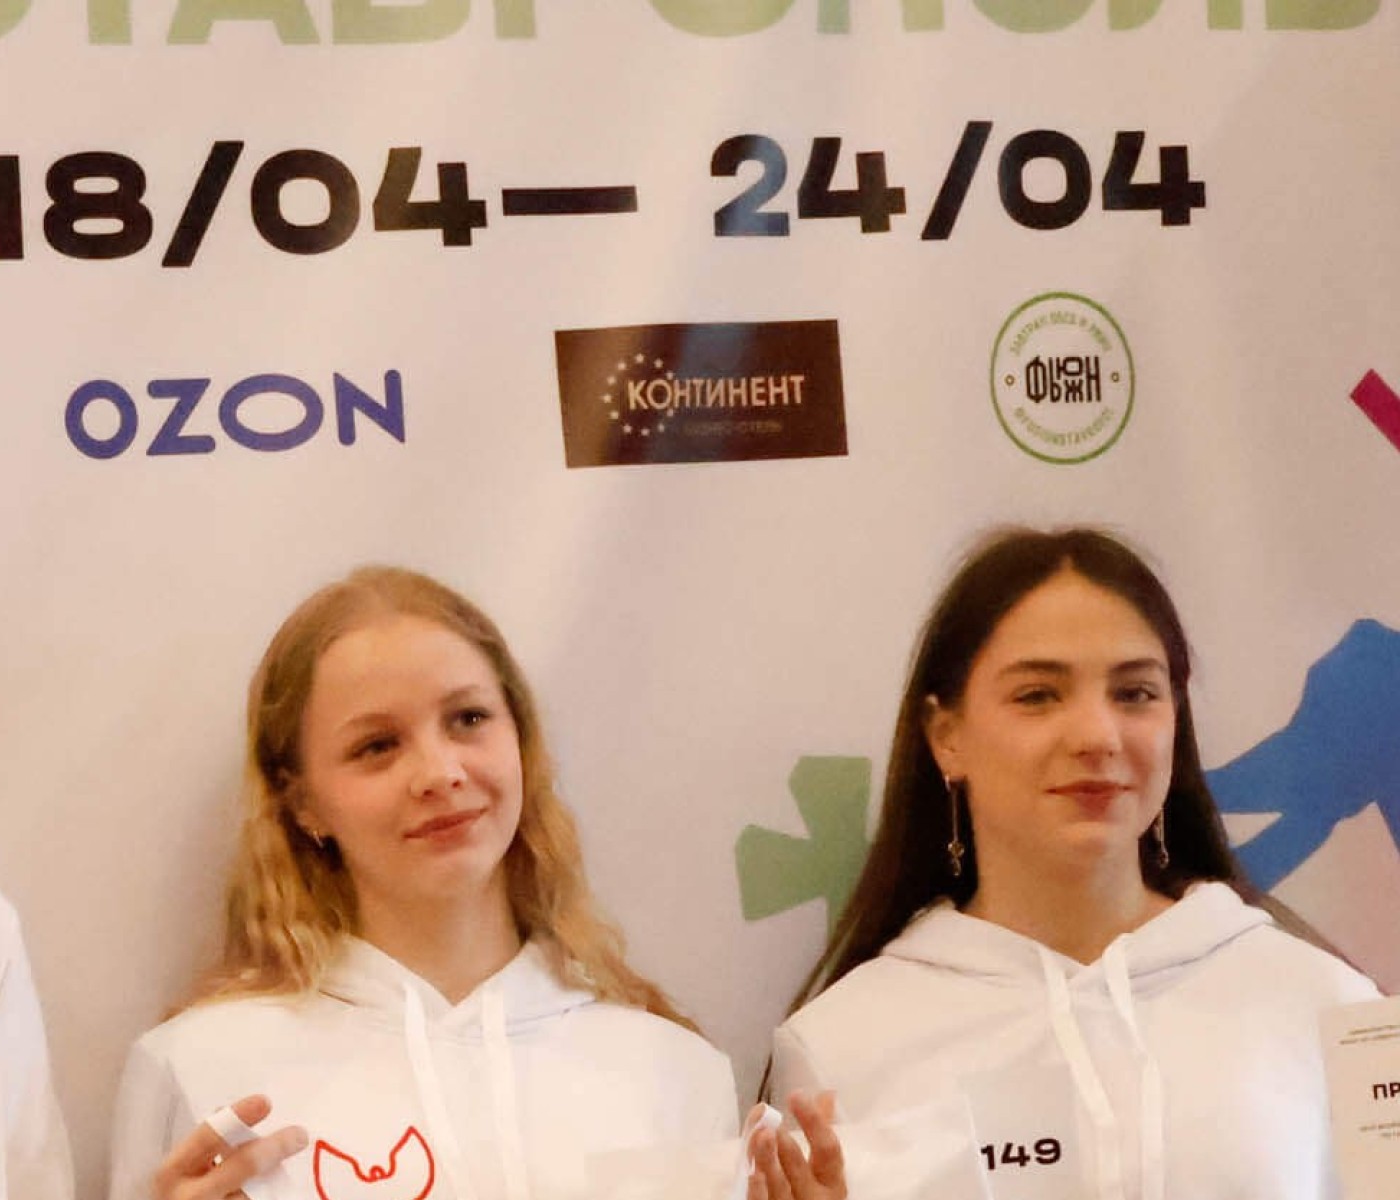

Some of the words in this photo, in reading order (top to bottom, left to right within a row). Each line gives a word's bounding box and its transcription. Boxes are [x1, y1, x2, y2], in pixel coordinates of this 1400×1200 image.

[709, 121, 1206, 241] 24/04
[65, 369, 406, 460] OZON
[627, 374, 805, 410] КОНТИНЕНТ
[980, 1138, 1062, 1170] 149
